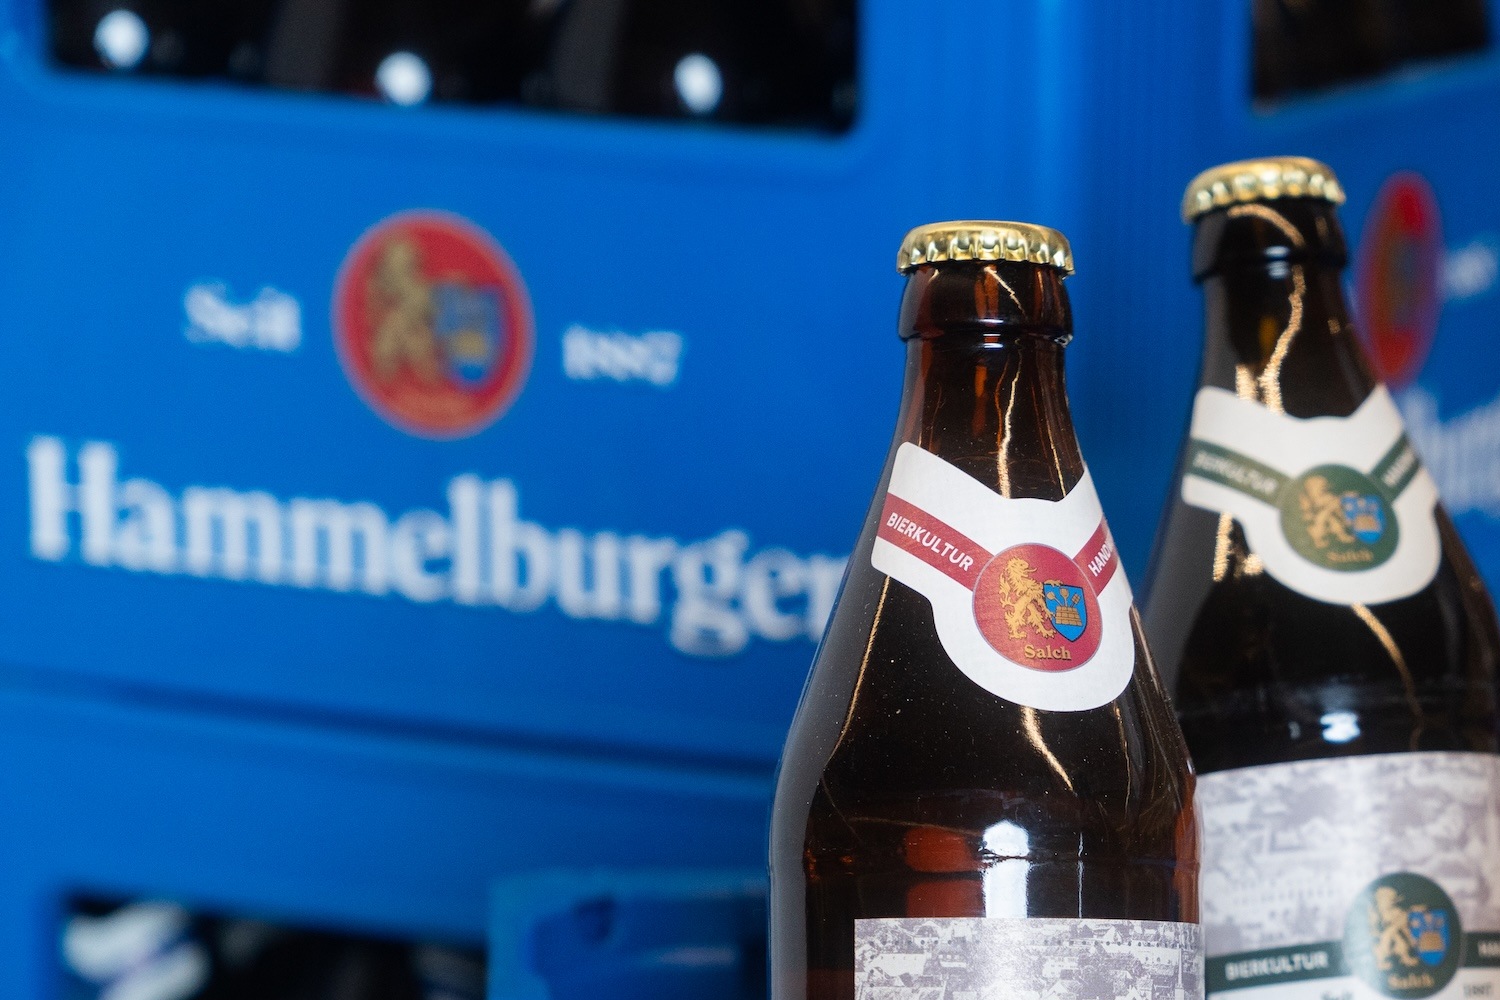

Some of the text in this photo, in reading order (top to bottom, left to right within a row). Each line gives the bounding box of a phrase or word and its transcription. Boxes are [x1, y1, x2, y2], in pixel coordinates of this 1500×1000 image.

[27, 434, 846, 656] Hammelburger
[885, 511, 975, 573] BIERKULTUR
[1024, 644, 1072, 661] Salch
[1225, 950, 1328, 980] BIERKULTUR
